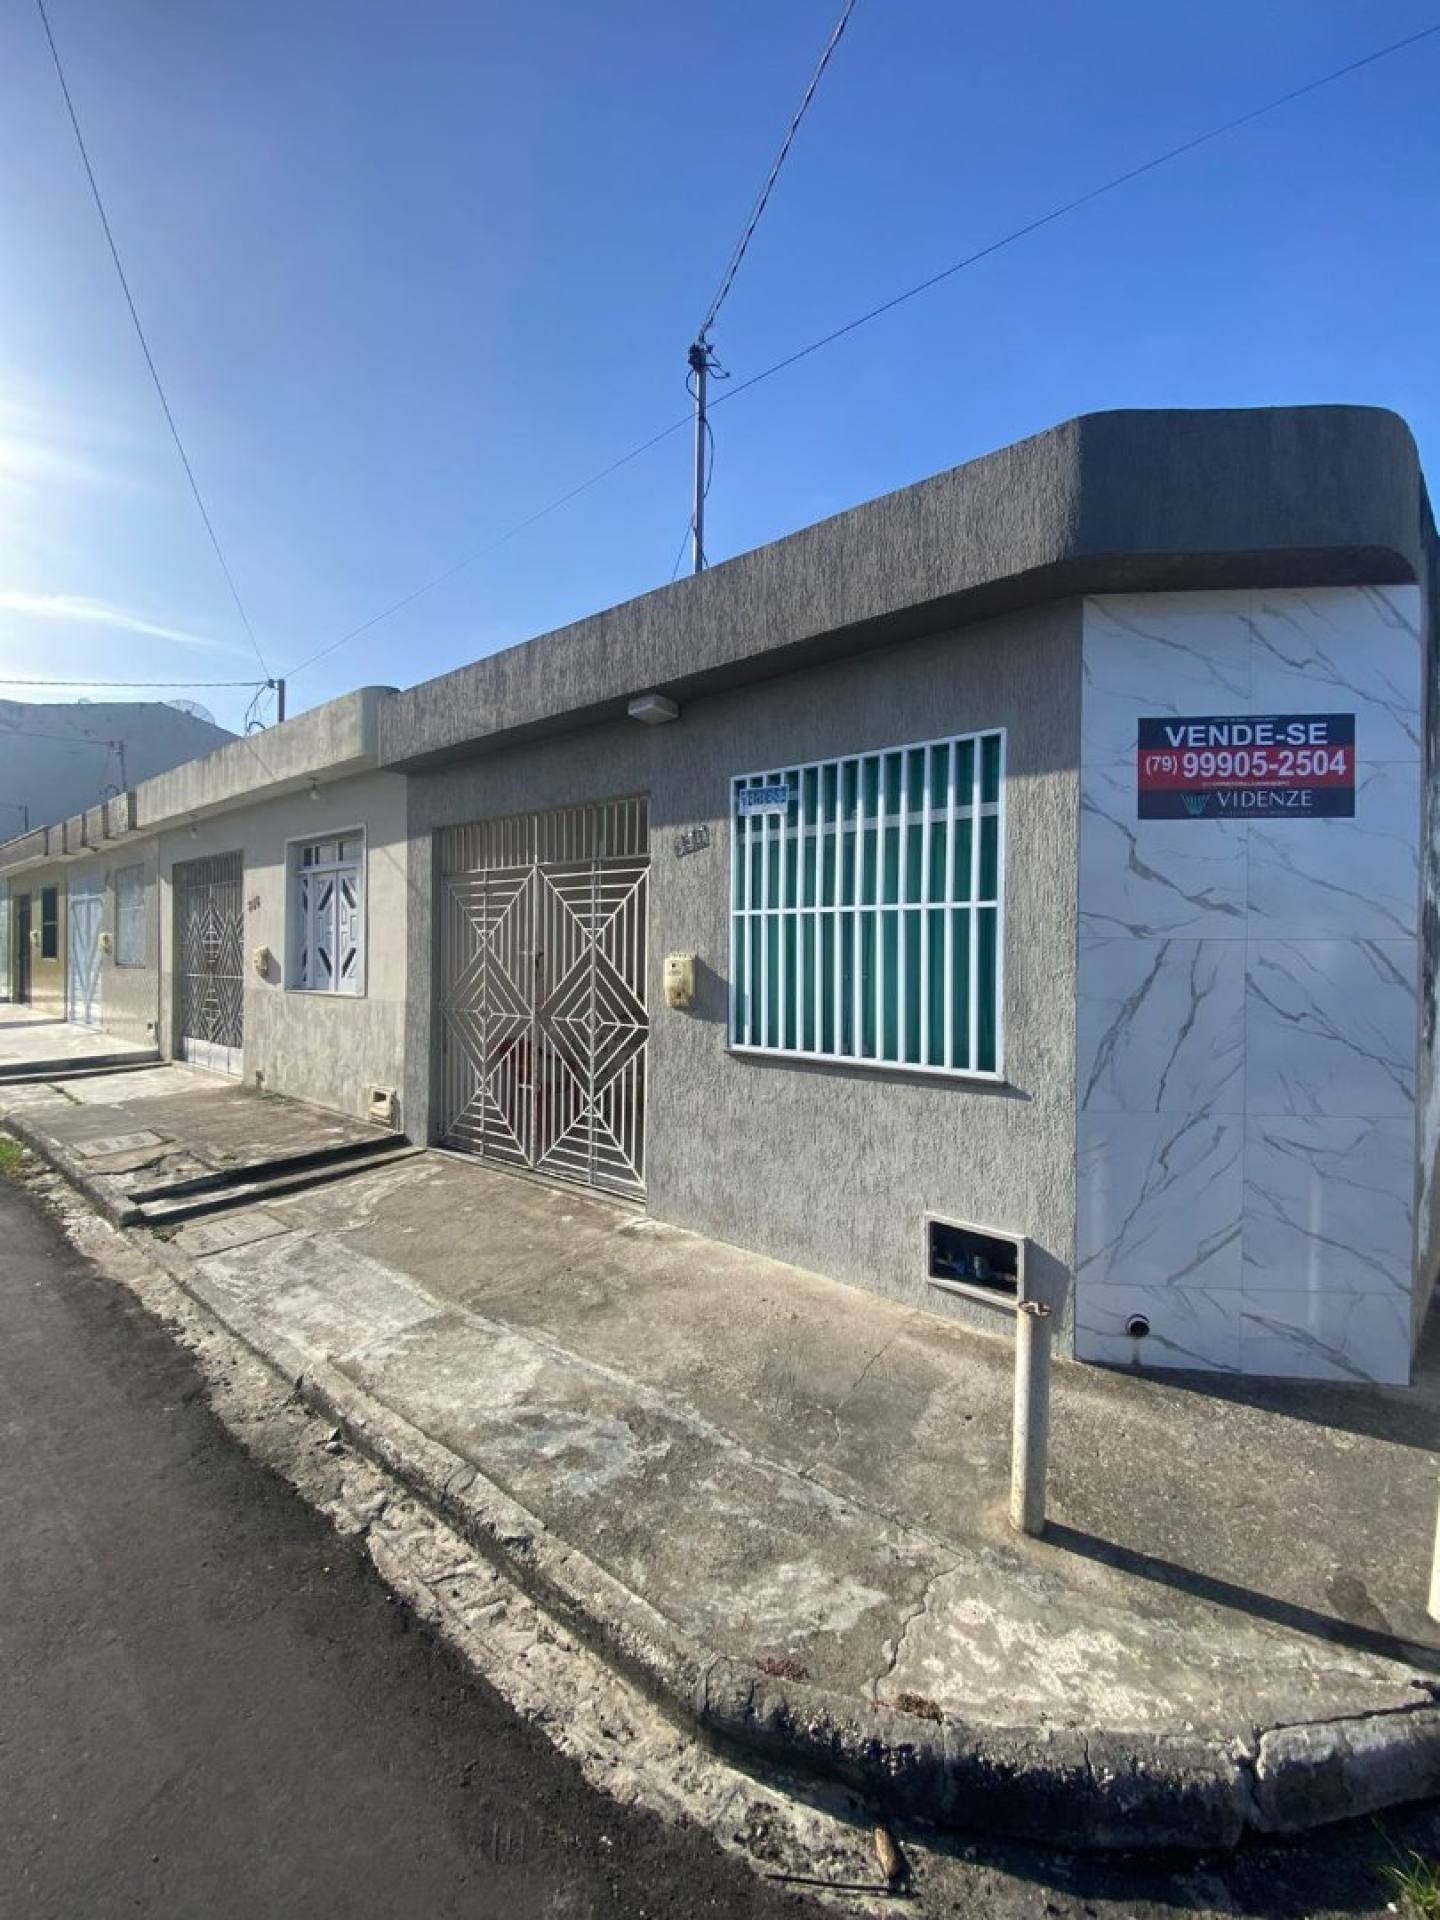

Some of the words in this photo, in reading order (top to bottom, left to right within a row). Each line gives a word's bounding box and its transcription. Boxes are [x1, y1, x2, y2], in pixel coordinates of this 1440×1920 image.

[1165, 723, 1328, 747] VENDE-SE
[1146, 755, 1178, 776] (79)
[1183, 750, 1346, 778] 99905-2504
[1217, 790, 1313, 808] VIDENZE
